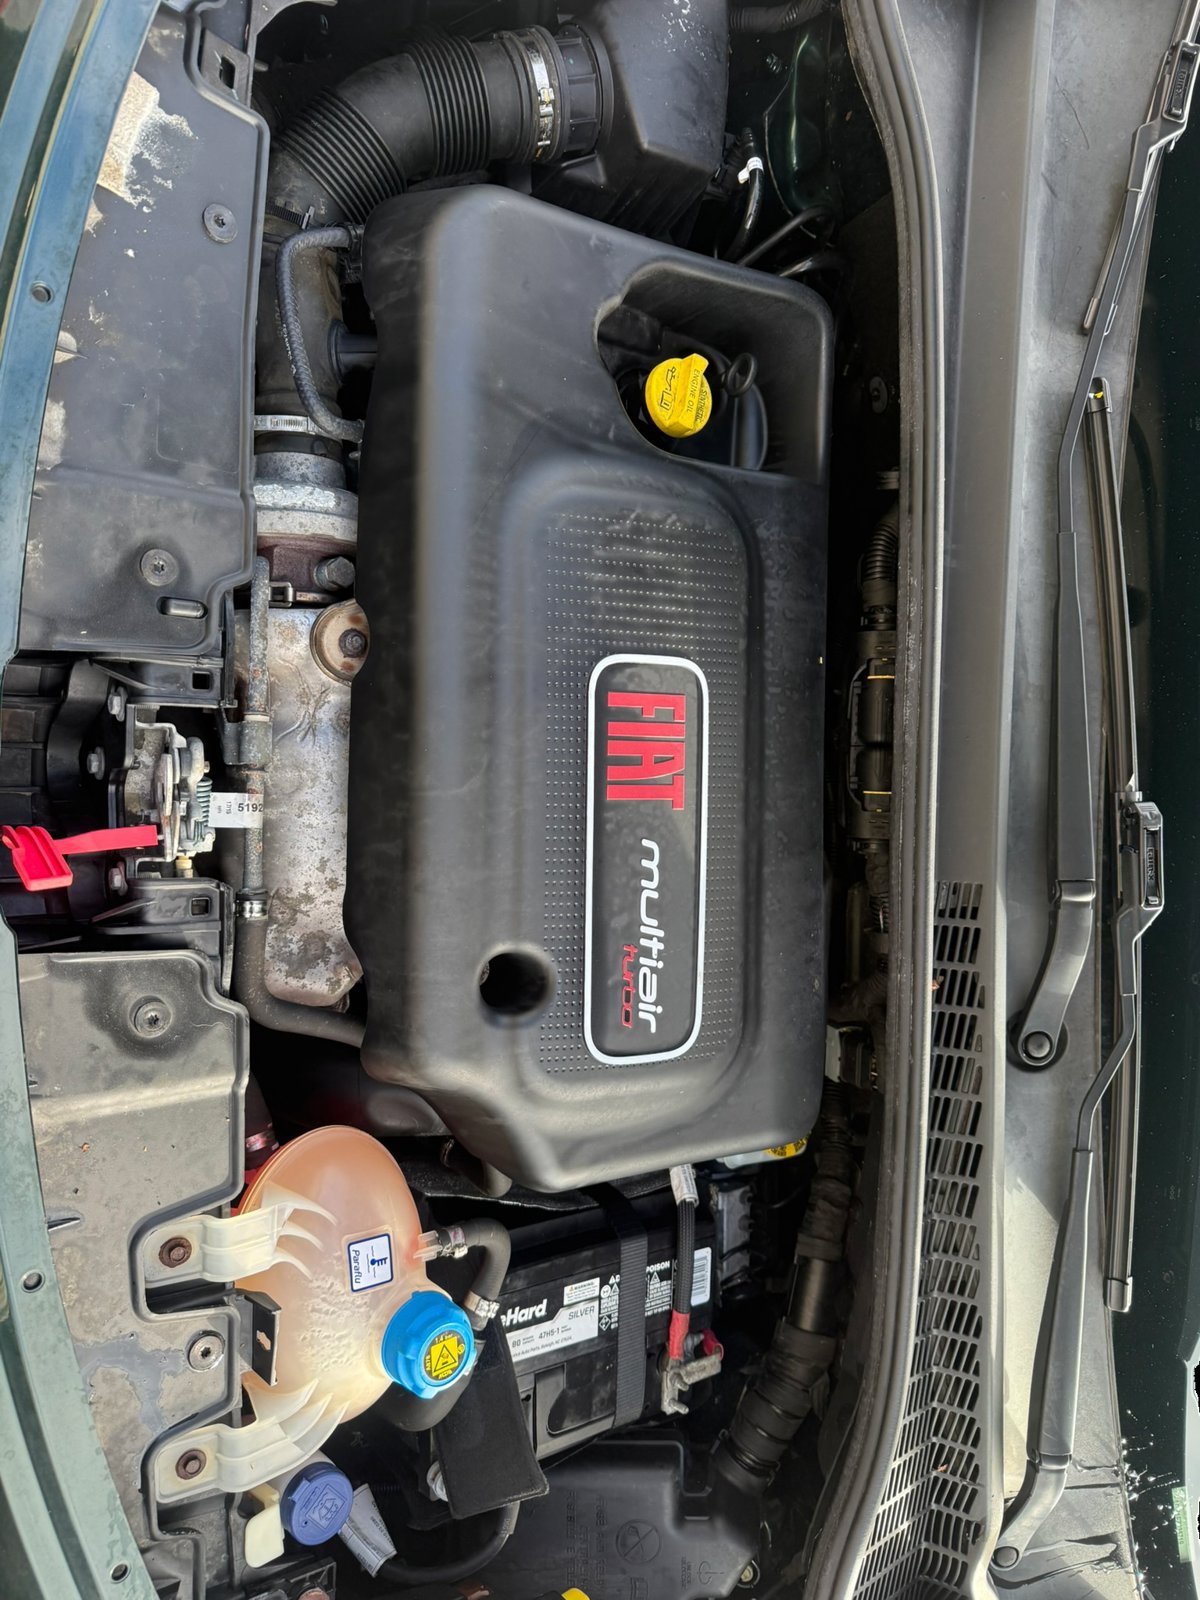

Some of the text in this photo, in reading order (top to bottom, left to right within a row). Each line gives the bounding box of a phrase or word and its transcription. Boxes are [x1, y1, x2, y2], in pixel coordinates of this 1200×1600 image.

[686, 369, 701, 414] ENGINE OIL
[695, 389, 708, 423] SYNTHETIC
[606, 691, 686, 811] FIAT
[638, 838, 664, 1033] multiair
[621, 944, 638, 1029] turbo
[351, 1249, 363, 1284] Paraflu
[568, 1305, 595, 1320] SILVER
